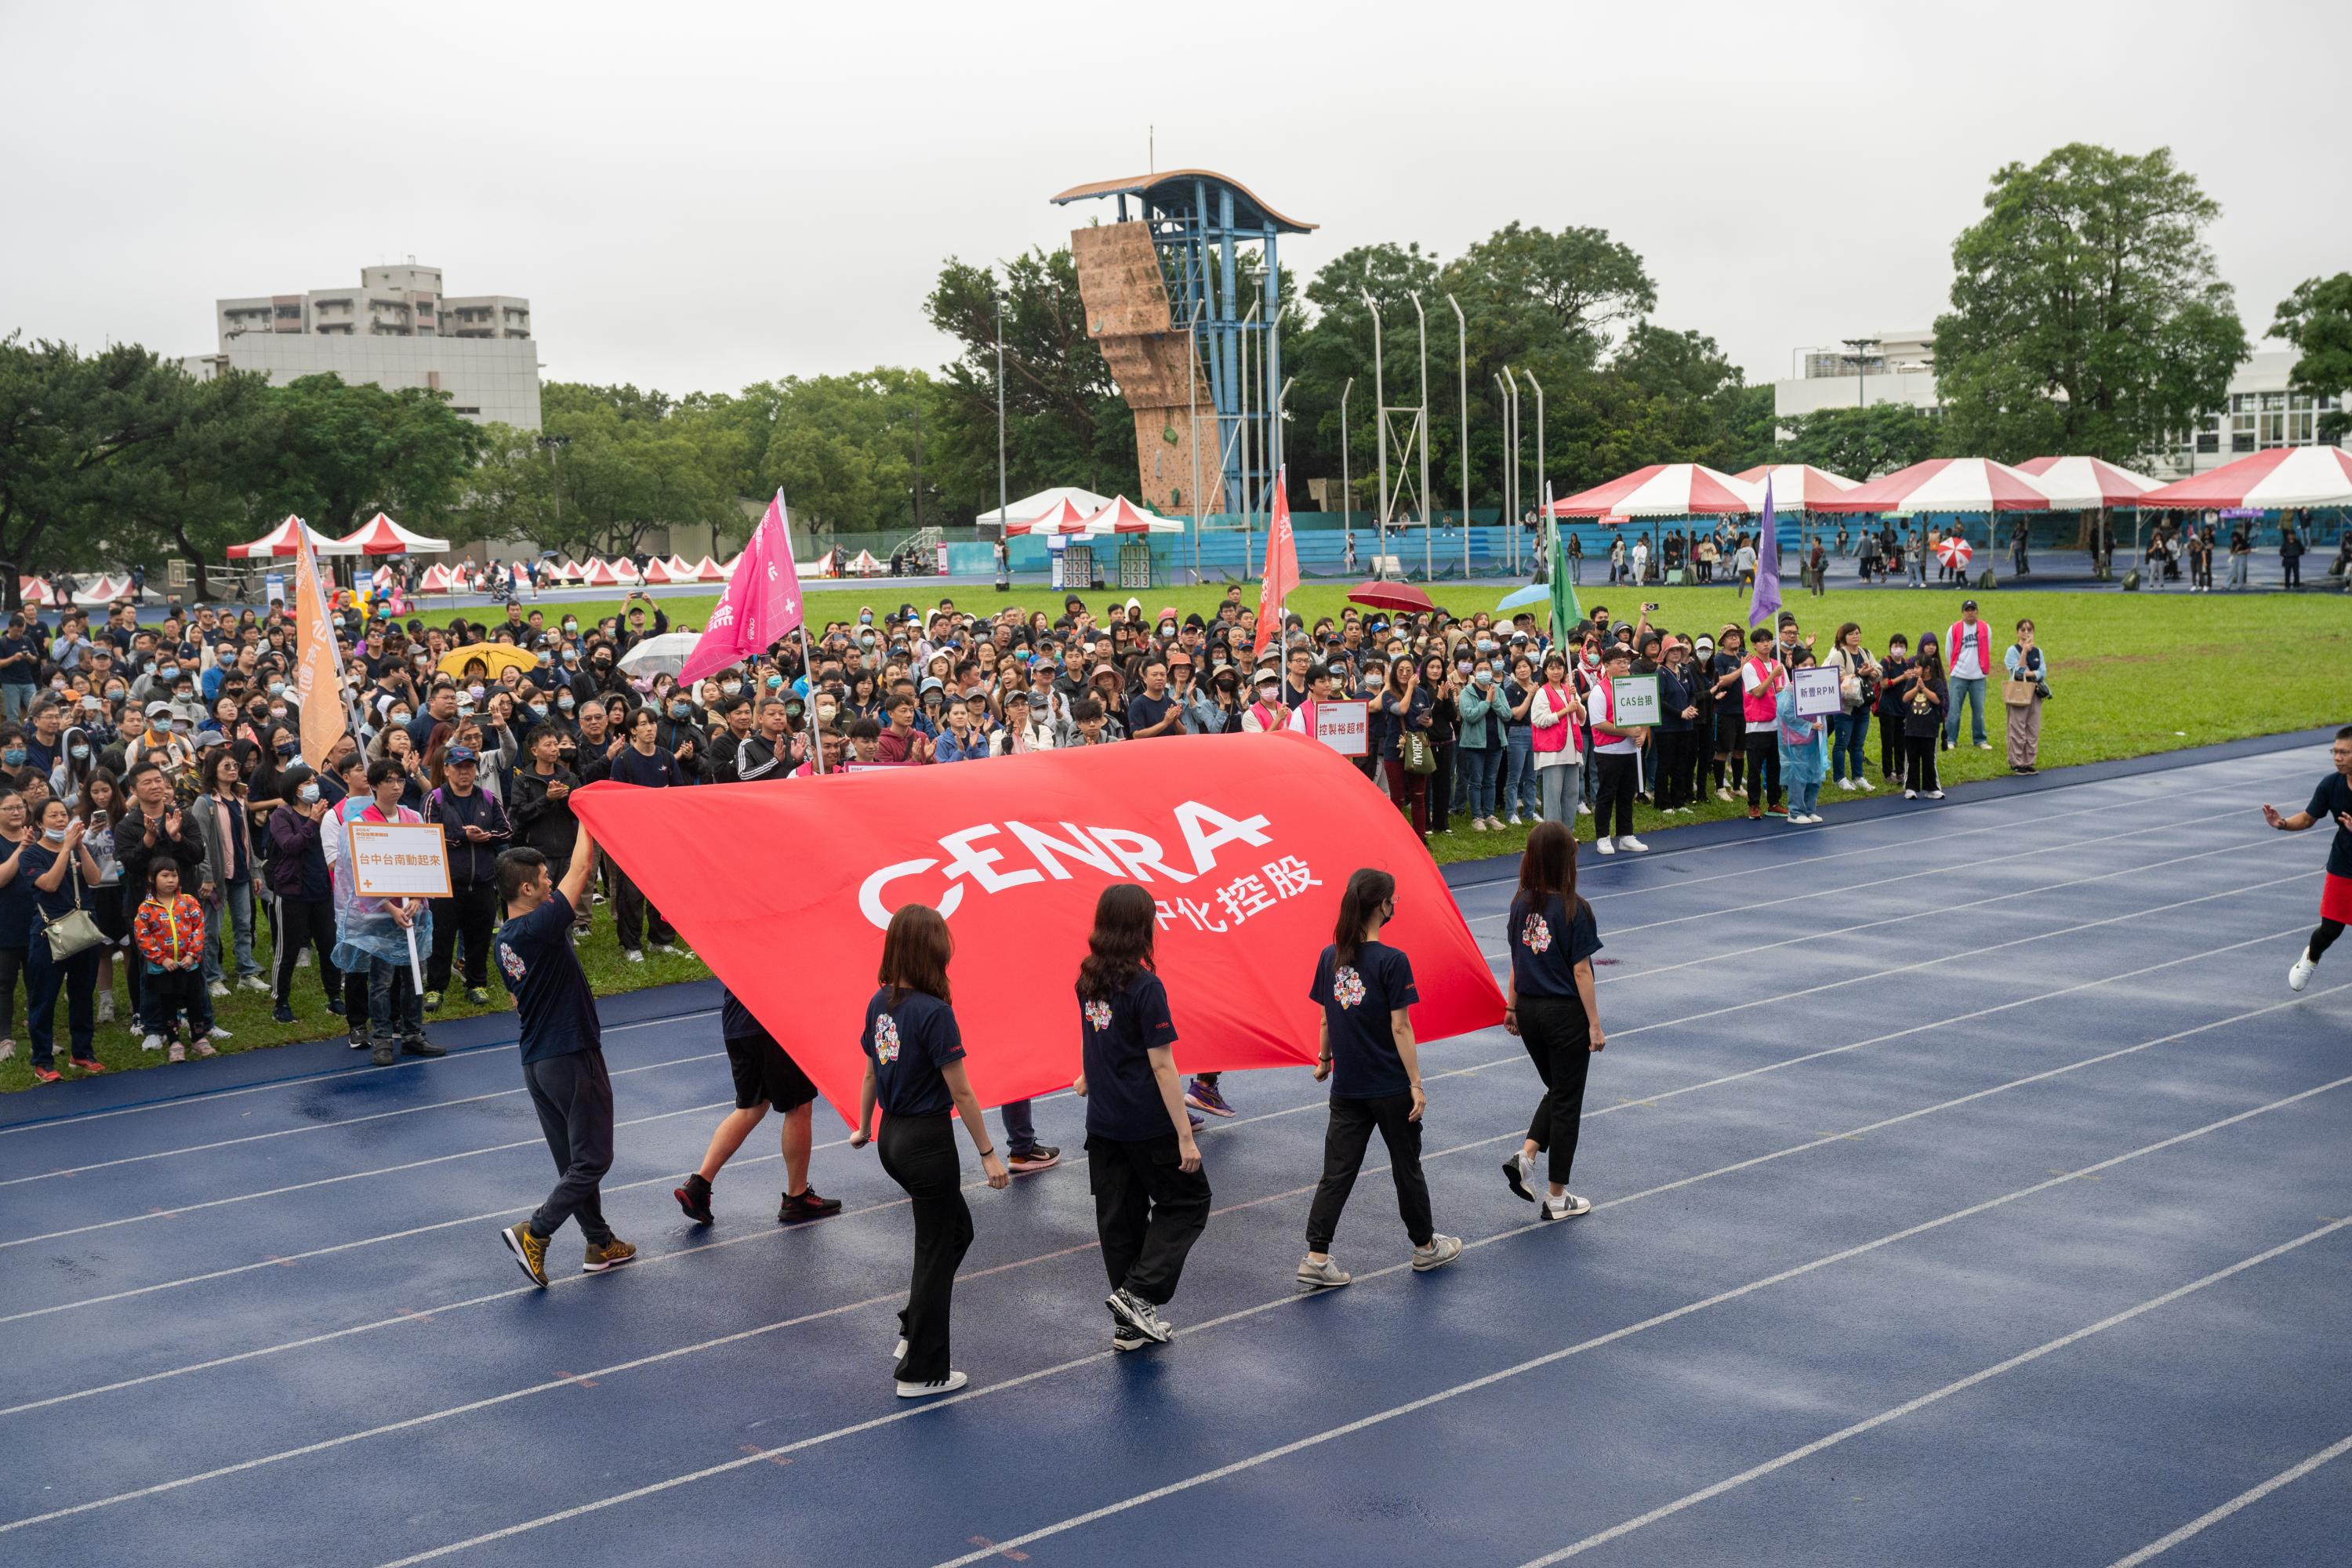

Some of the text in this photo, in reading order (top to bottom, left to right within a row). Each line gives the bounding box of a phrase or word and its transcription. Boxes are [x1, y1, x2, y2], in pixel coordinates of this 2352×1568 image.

[1800, 685, 1835, 698] 新豐RPM
[1621, 695, 1653, 706] CAS台狼
[1319, 722, 1365, 736] 控製裕超標
[359, 853, 441, 866] 台中台南動起來
[858, 800, 1274, 931] CENRA
